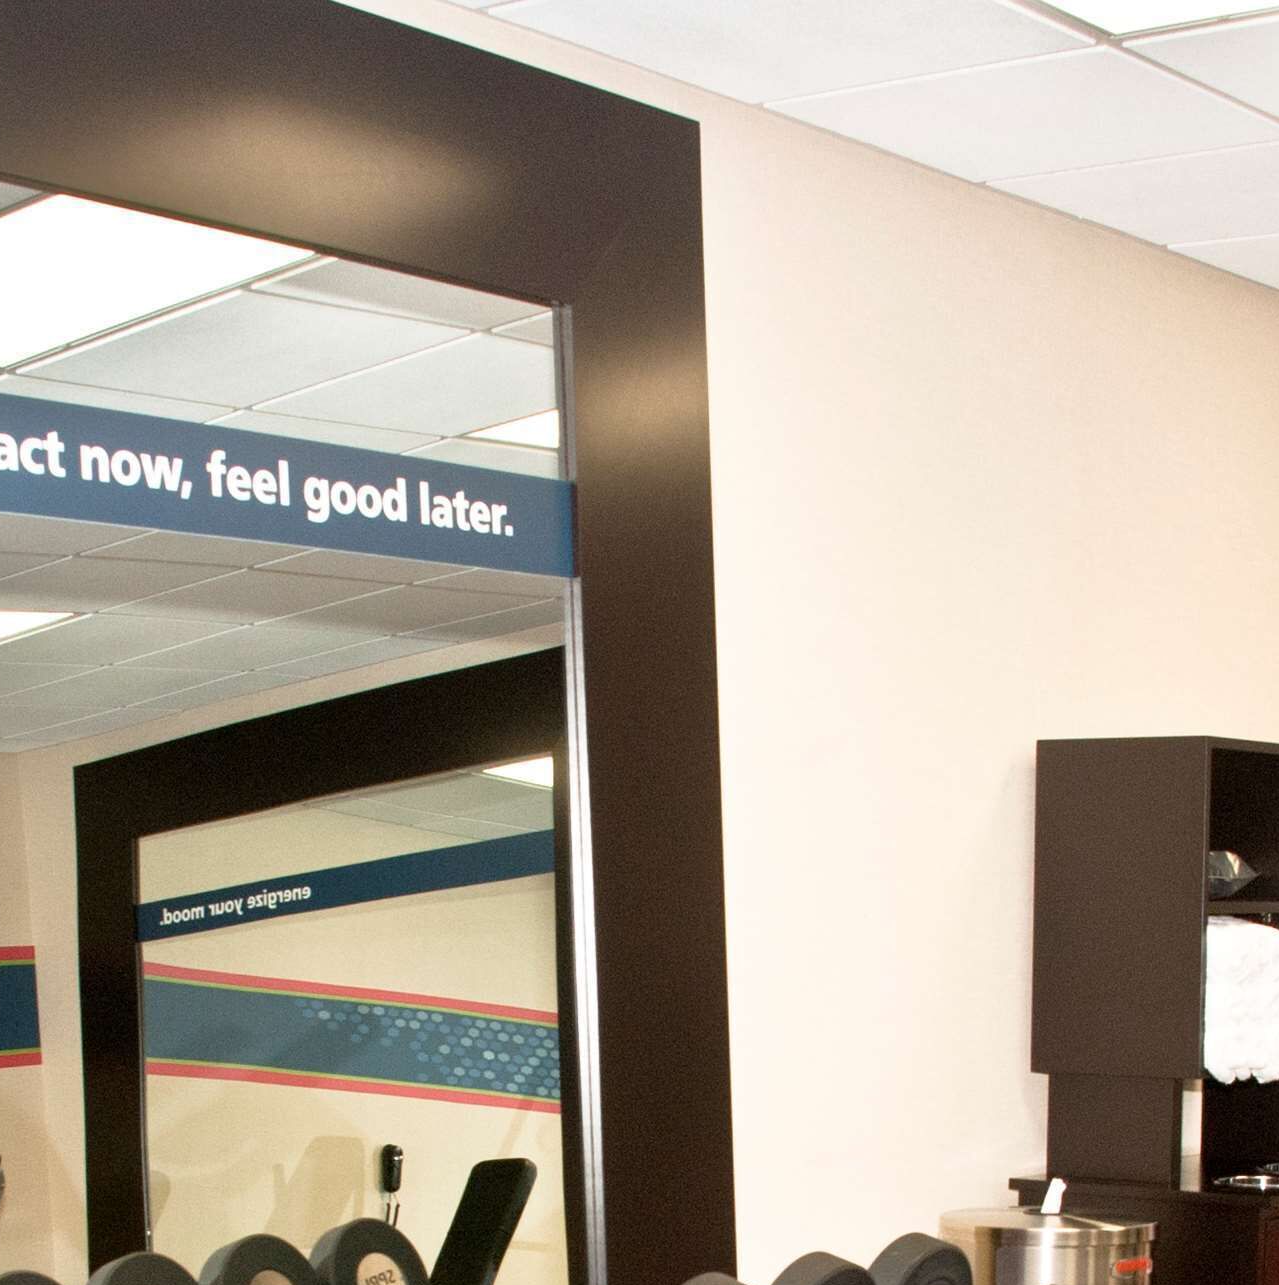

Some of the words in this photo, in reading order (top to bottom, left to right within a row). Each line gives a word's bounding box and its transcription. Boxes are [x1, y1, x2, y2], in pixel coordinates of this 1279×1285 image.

[80, 443, 192, 500] now,
[206, 450, 290, 506] feel
[304, 476, 408, 523] good
[420, 481, 514, 536] later.
